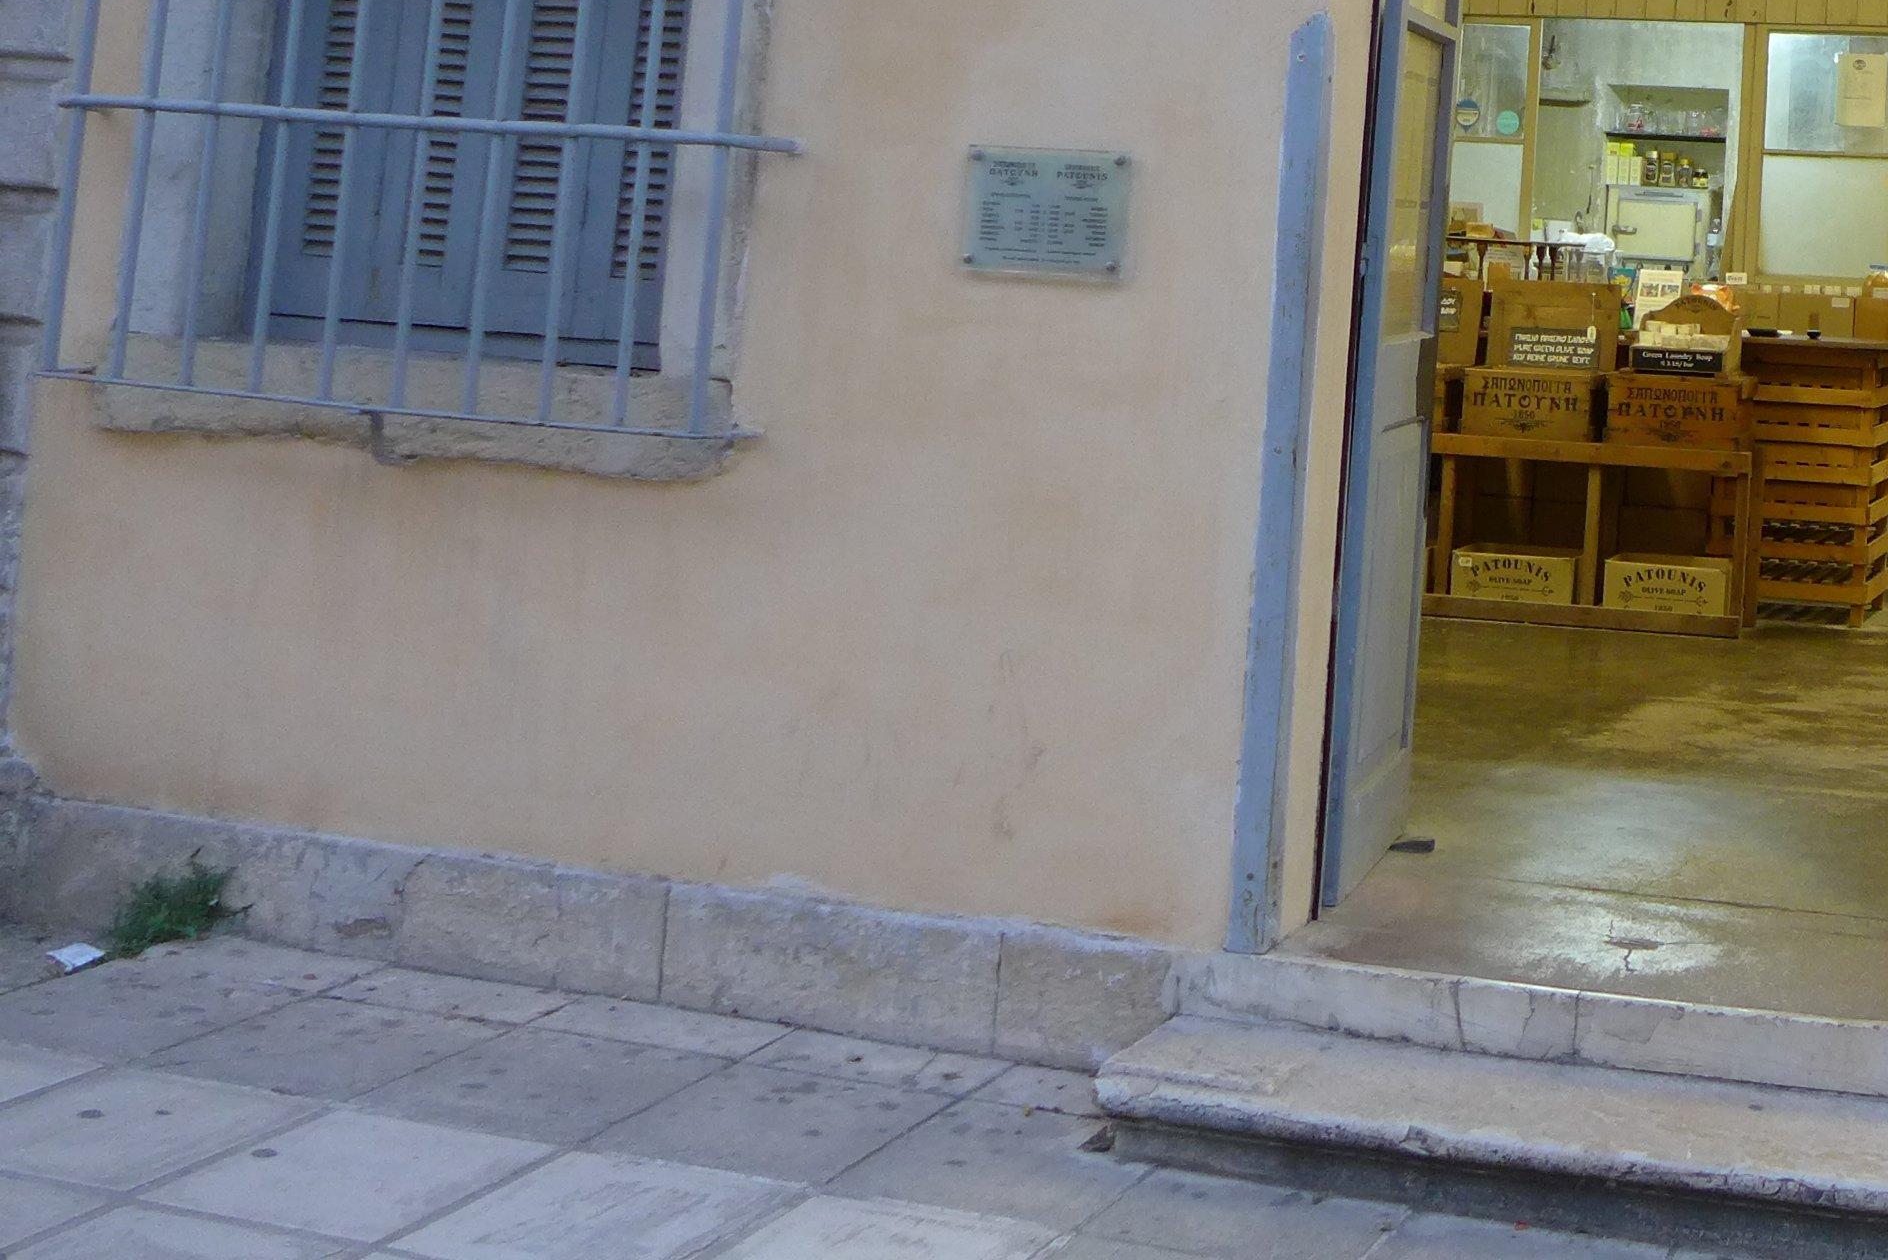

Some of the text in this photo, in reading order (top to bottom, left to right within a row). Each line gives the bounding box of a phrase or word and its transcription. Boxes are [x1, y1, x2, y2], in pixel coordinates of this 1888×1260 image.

[1472, 392, 1579, 412] ΠΑΤΟΥΝΗ
[1470, 558, 1552, 582] PATOUNIS
[1622, 568, 1707, 592] PATOUNIS
